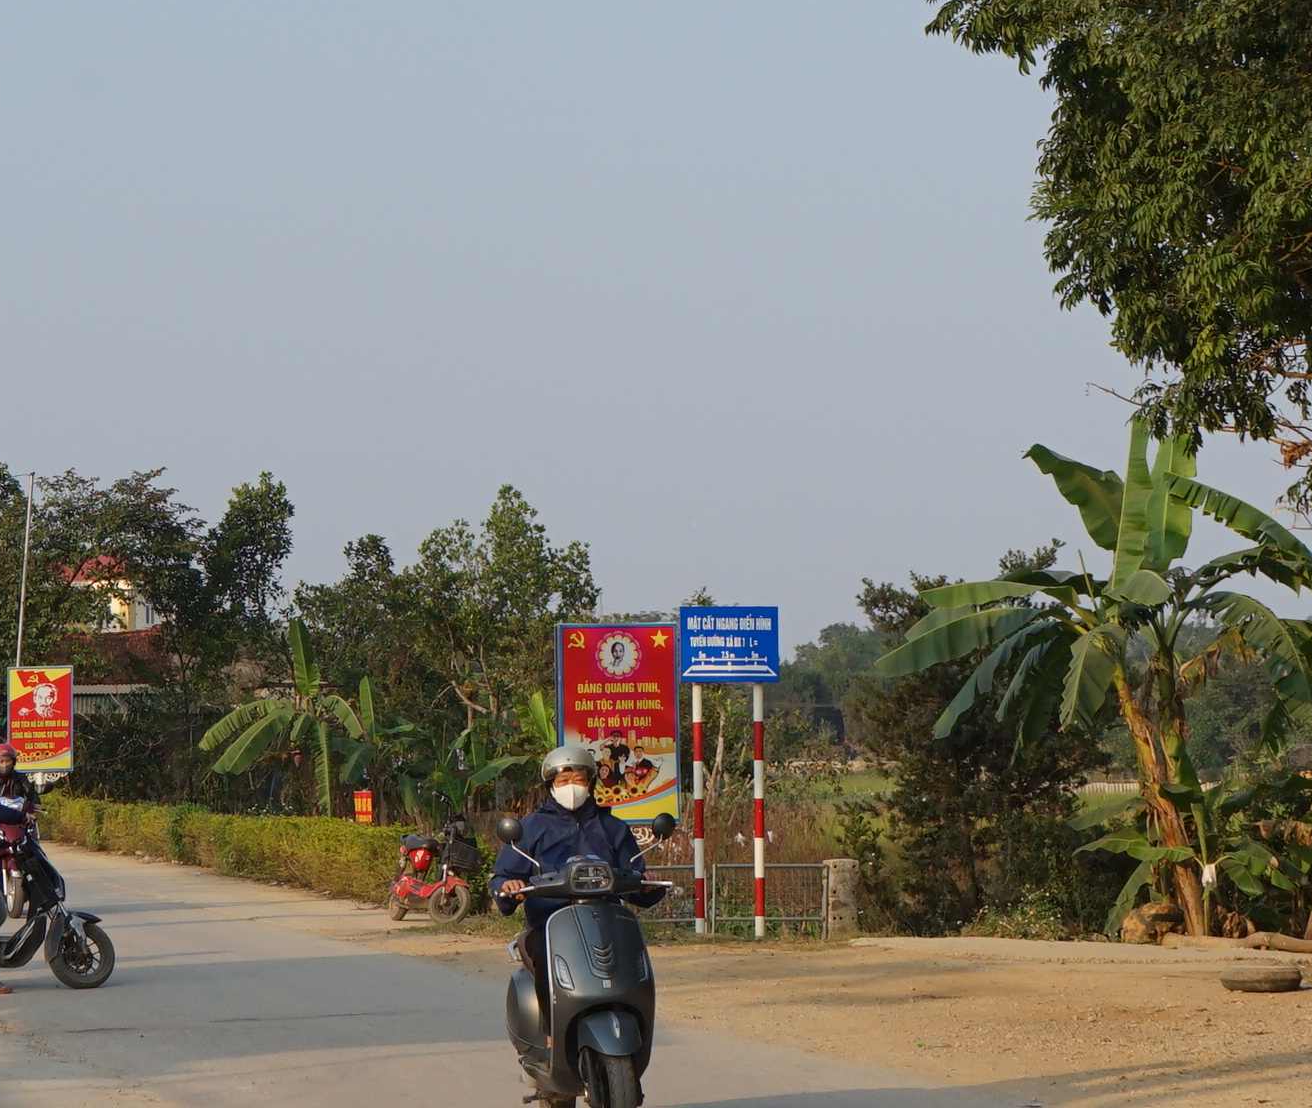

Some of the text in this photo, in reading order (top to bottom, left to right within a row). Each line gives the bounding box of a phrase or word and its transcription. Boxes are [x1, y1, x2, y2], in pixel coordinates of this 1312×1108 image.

[716, 617, 738, 631] NGANG
[577, 680, 661, 694] ĐẢNG QUANG VINH,
[575, 697, 664, 713] DÂN TỘC ANH HÙNG,
[587, 714, 652, 729] BÁC HỒ VĨ ĐẠI!
